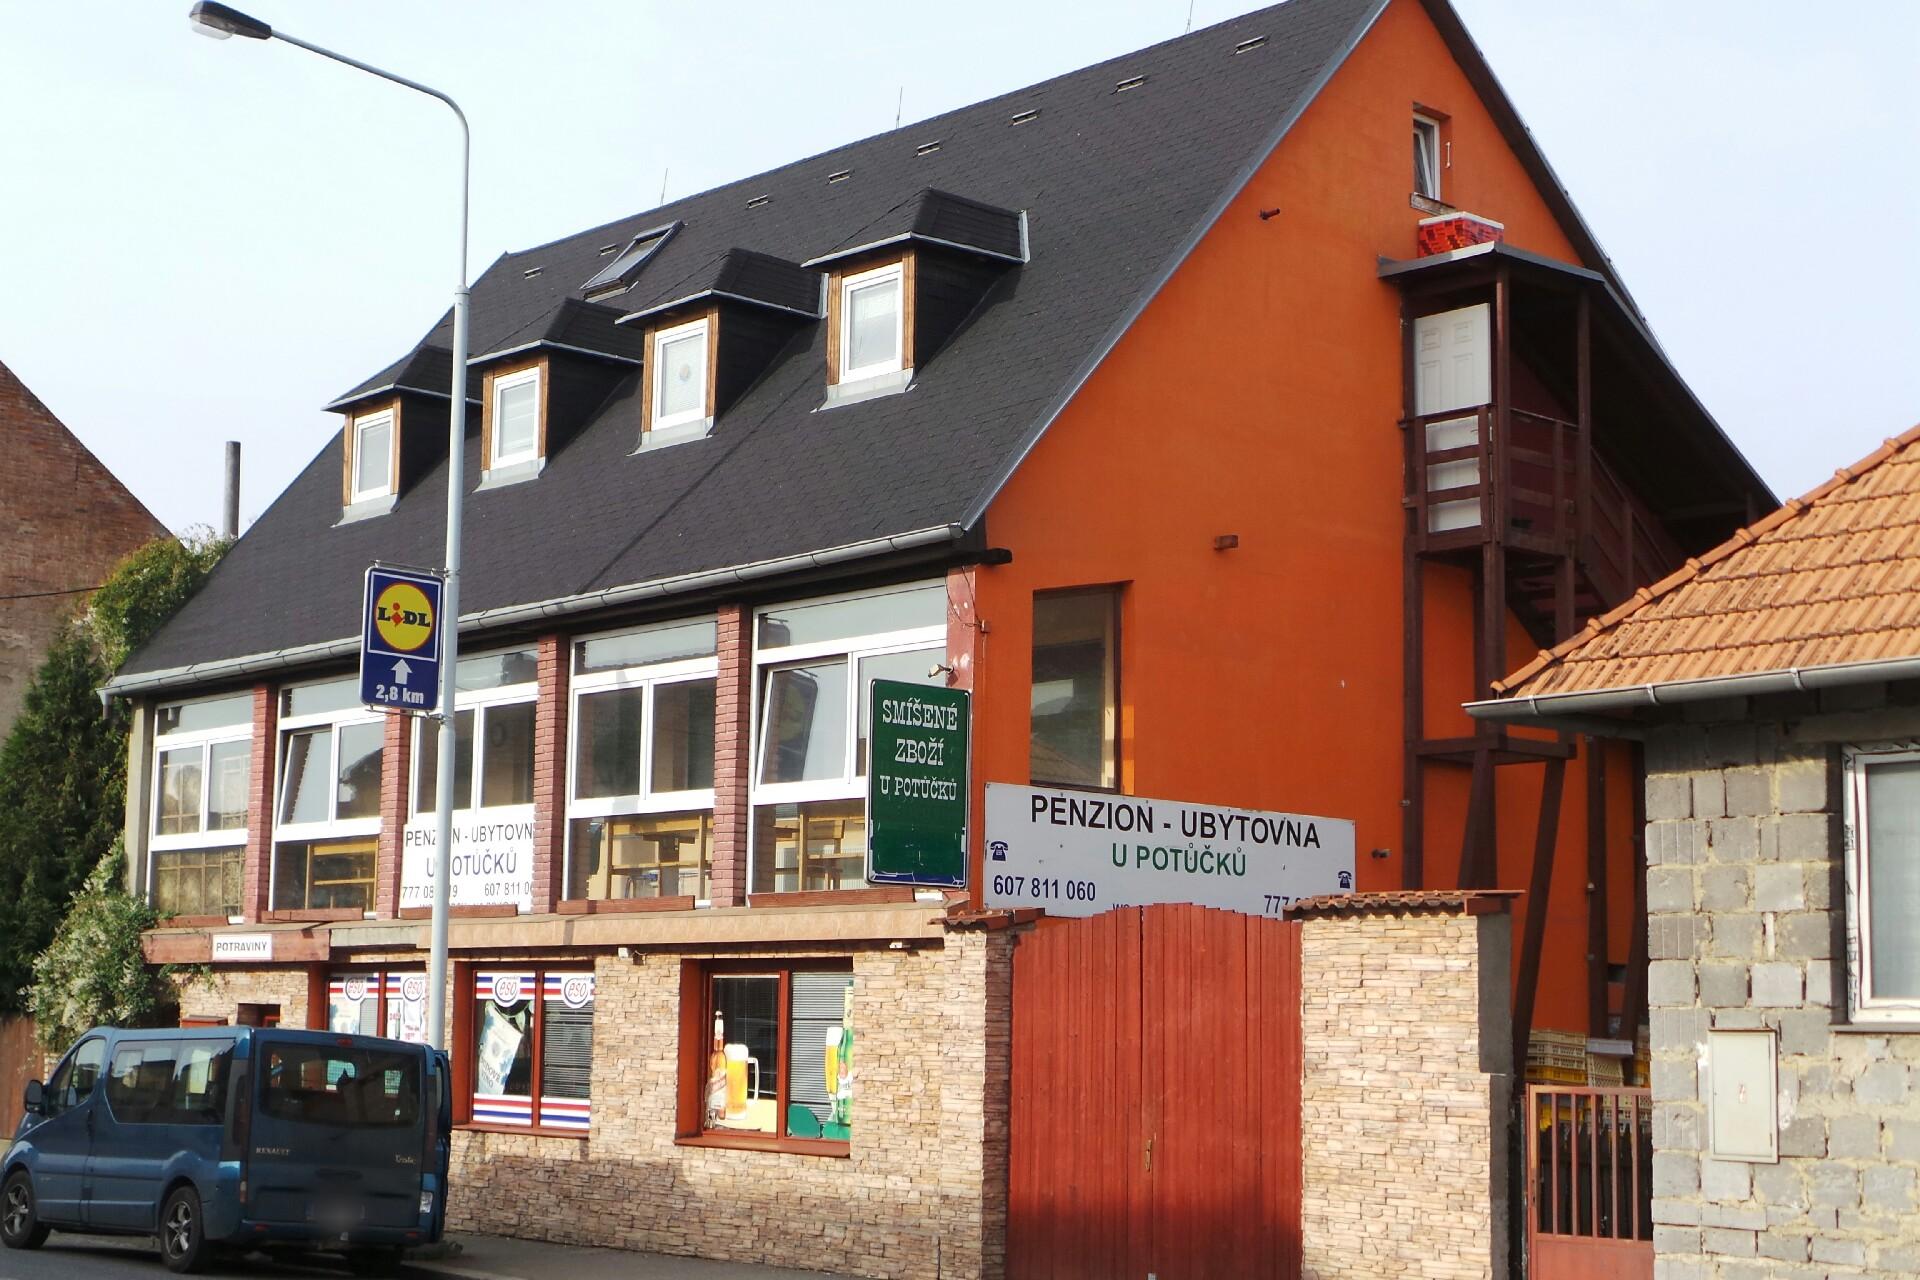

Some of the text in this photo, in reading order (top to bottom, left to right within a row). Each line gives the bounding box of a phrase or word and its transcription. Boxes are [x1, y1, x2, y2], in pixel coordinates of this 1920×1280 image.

[375, 684, 424, 704] 2,8 km
[882, 697, 958, 731] SMÍŠENÉ
[894, 737, 944, 766] ZBOŽÍ
[879, 775, 958, 801] U POTŮČKŮ
[1031, 795, 1153, 833] PENZION
[1181, 810, 1321, 848] UBYTOVNA
[1112, 843, 1246, 876] U POTŮČKŮ
[402, 886, 420, 900] 777
[484, 882, 501, 897] 607
[504, 881, 520, 896] 811
[993, 875, 1096, 901] 607 811 060
[216, 942, 267, 952] POTRAVINY
